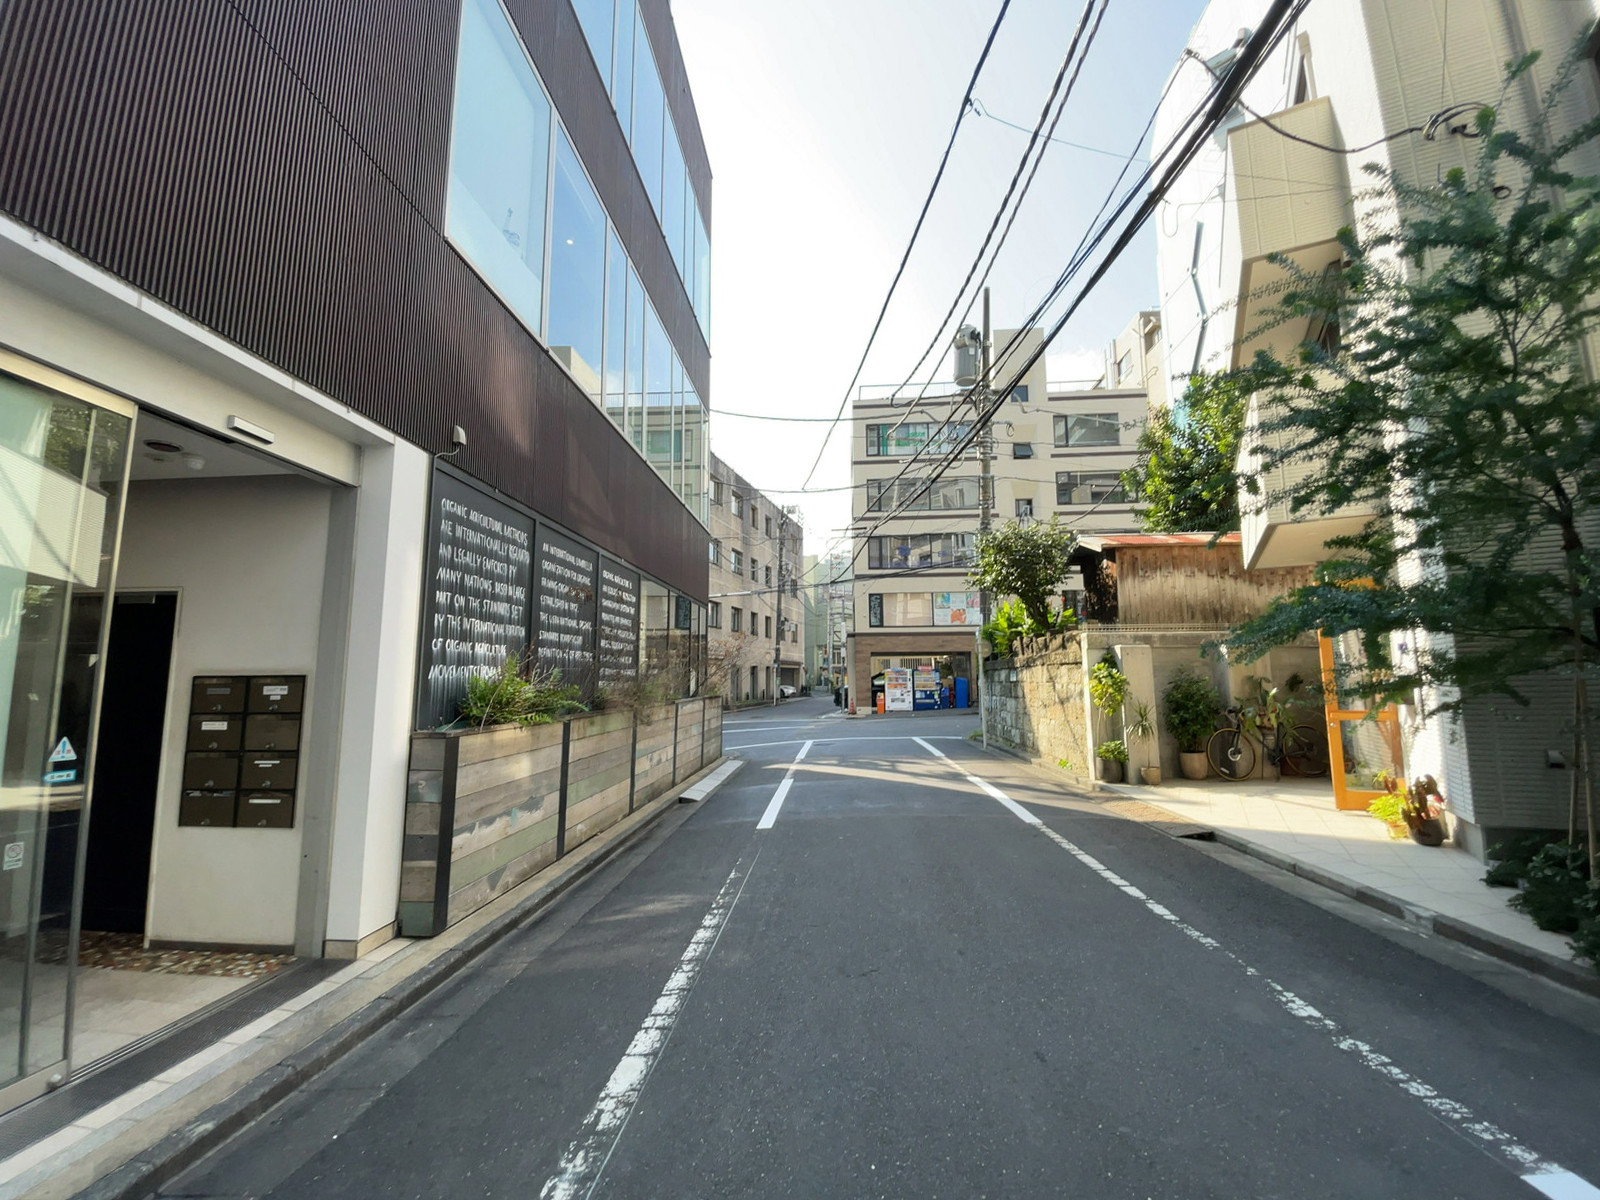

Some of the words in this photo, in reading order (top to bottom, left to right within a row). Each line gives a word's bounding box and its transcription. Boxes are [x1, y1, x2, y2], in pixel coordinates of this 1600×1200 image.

[441, 498, 468, 519] ORGANIC
[440, 519, 453, 535] ARE
[439, 542, 452, 559] AND
[453, 546, 482, 567] LEGALLY
[436, 567, 462, 583] MANY
[435, 590, 452, 604] PART
[454, 593, 466, 607] ON
[468, 596, 481, 610] THE
[511, 604, 524, 617] SET
[434, 613, 445, 626] BY
[447, 614, 462, 629] THE
[431, 638, 444, 650] OF
[445, 638, 473, 654] ORGANIC
